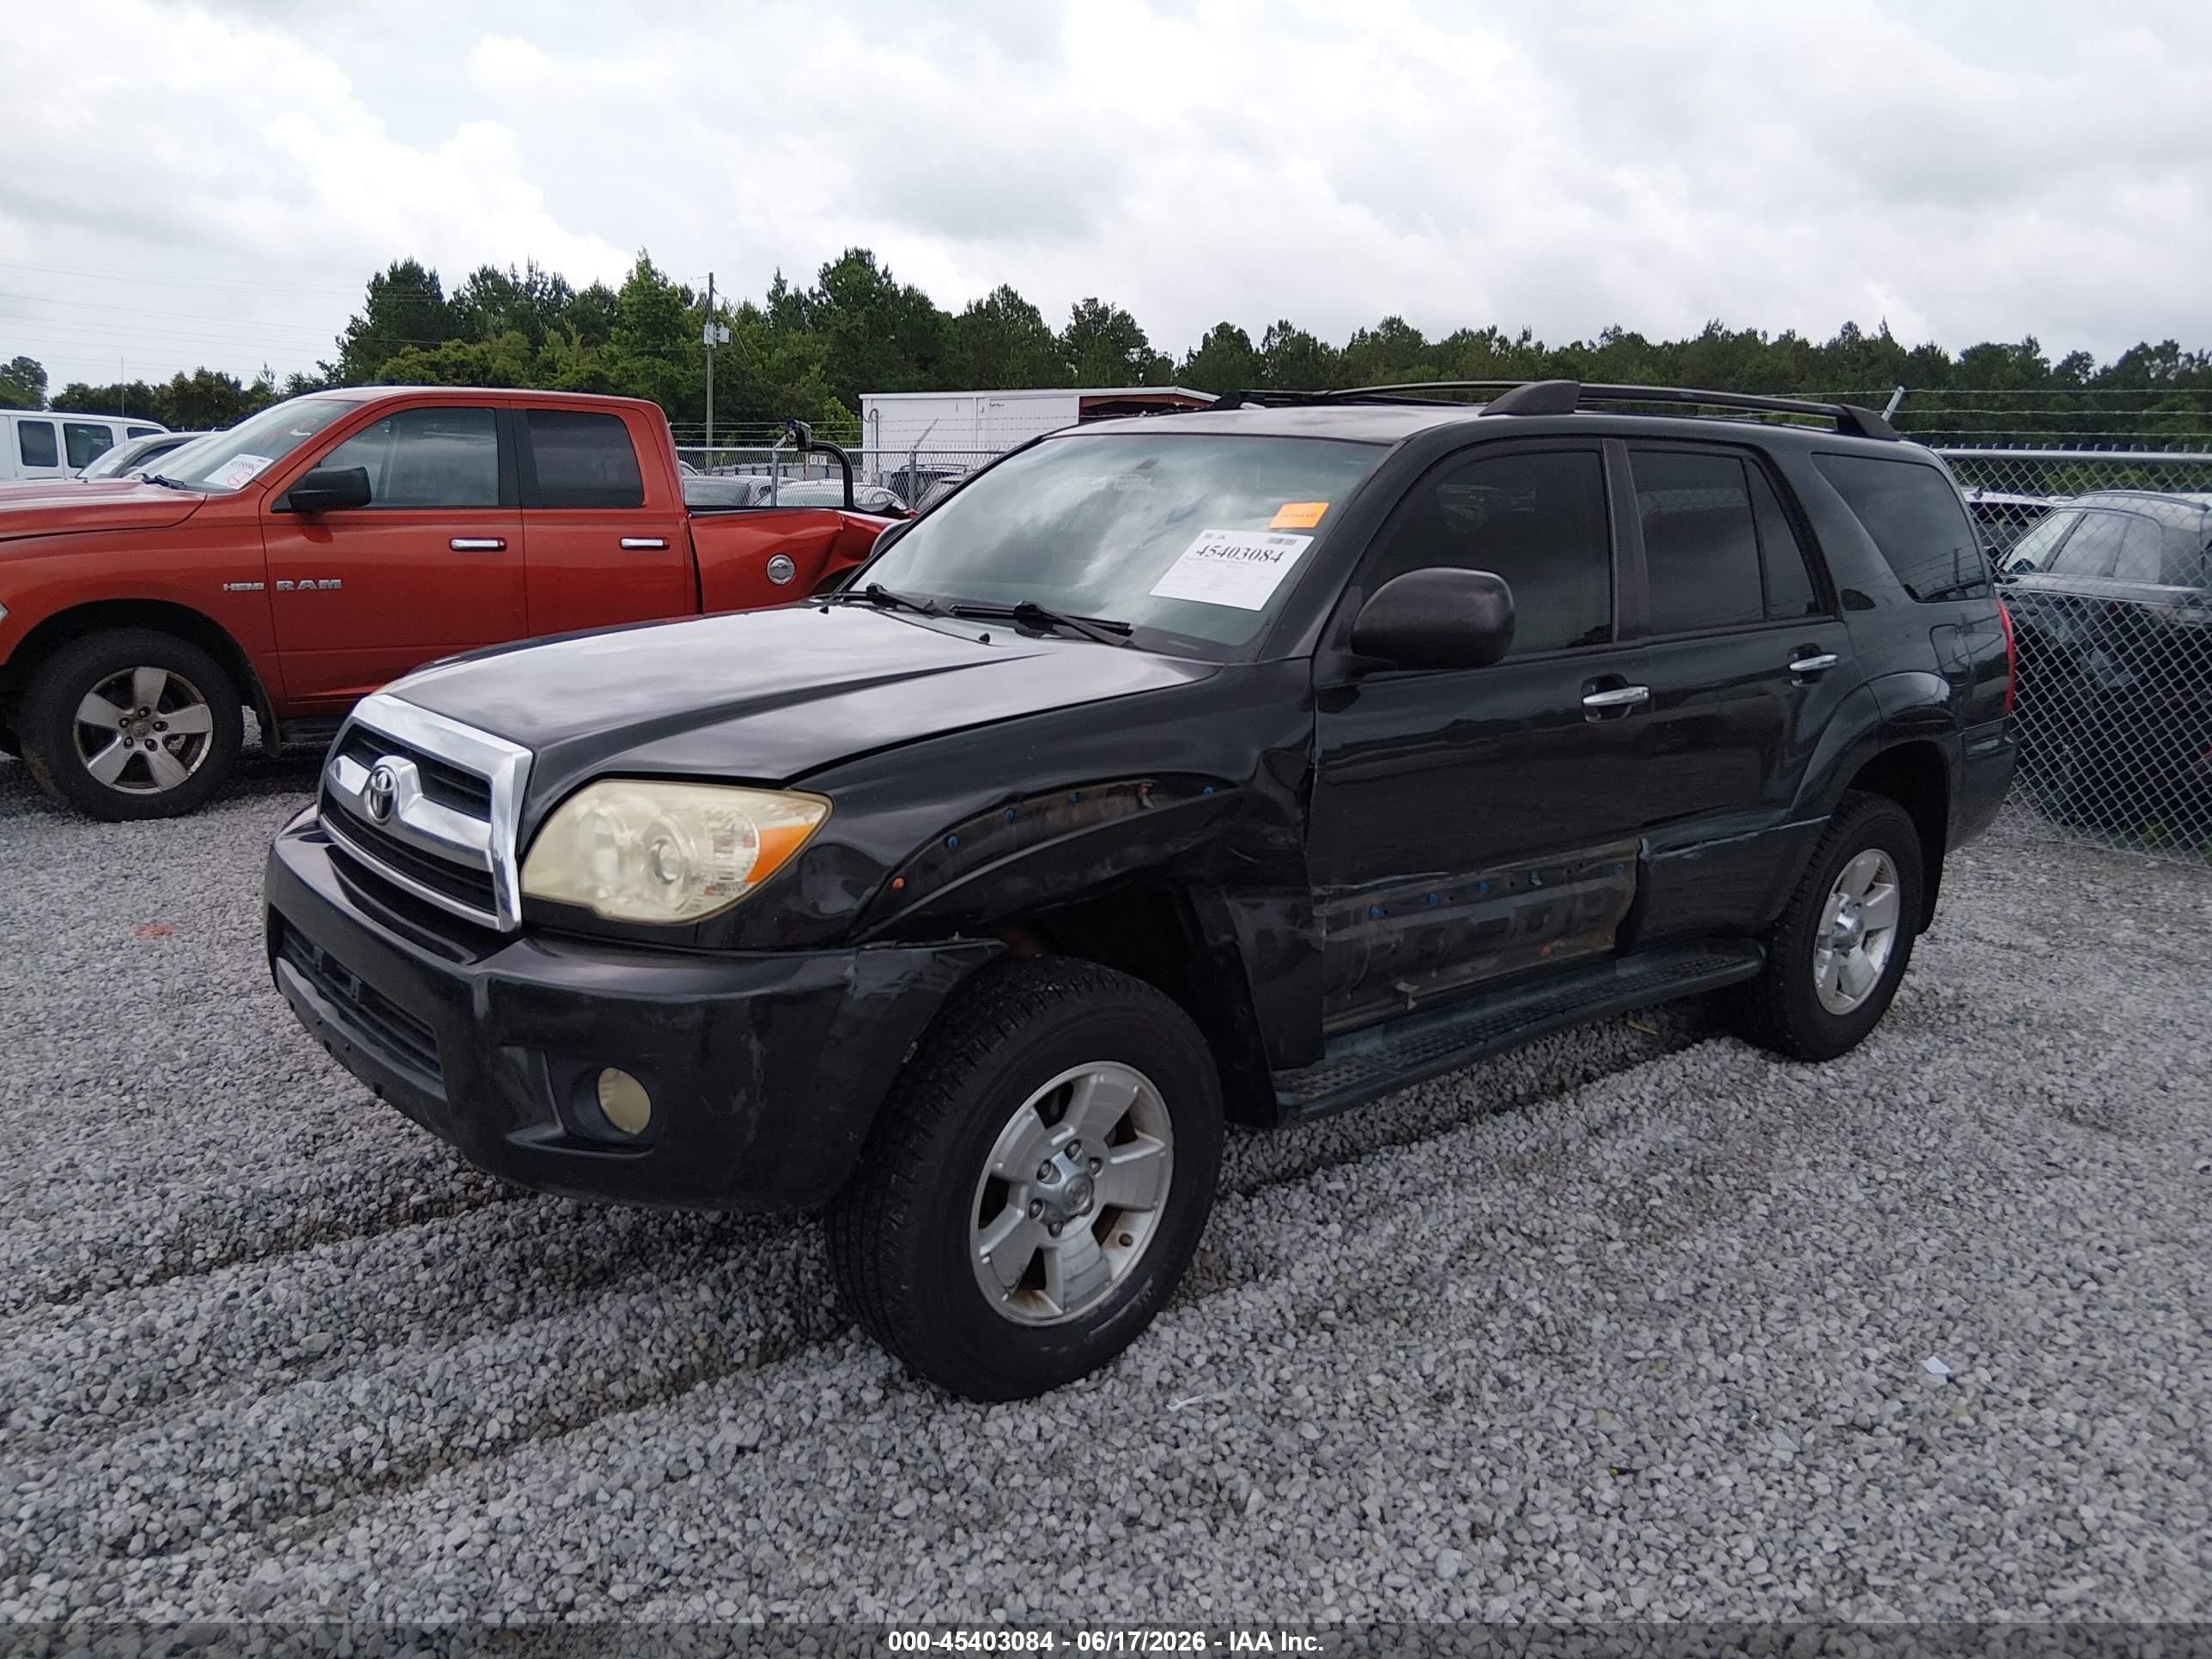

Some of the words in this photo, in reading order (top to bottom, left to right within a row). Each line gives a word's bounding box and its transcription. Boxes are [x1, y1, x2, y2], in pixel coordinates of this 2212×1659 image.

[1196, 544, 1285, 563] 45403084
[223, 582, 264, 592] HEMI
[276, 579, 342, 591] RAM
